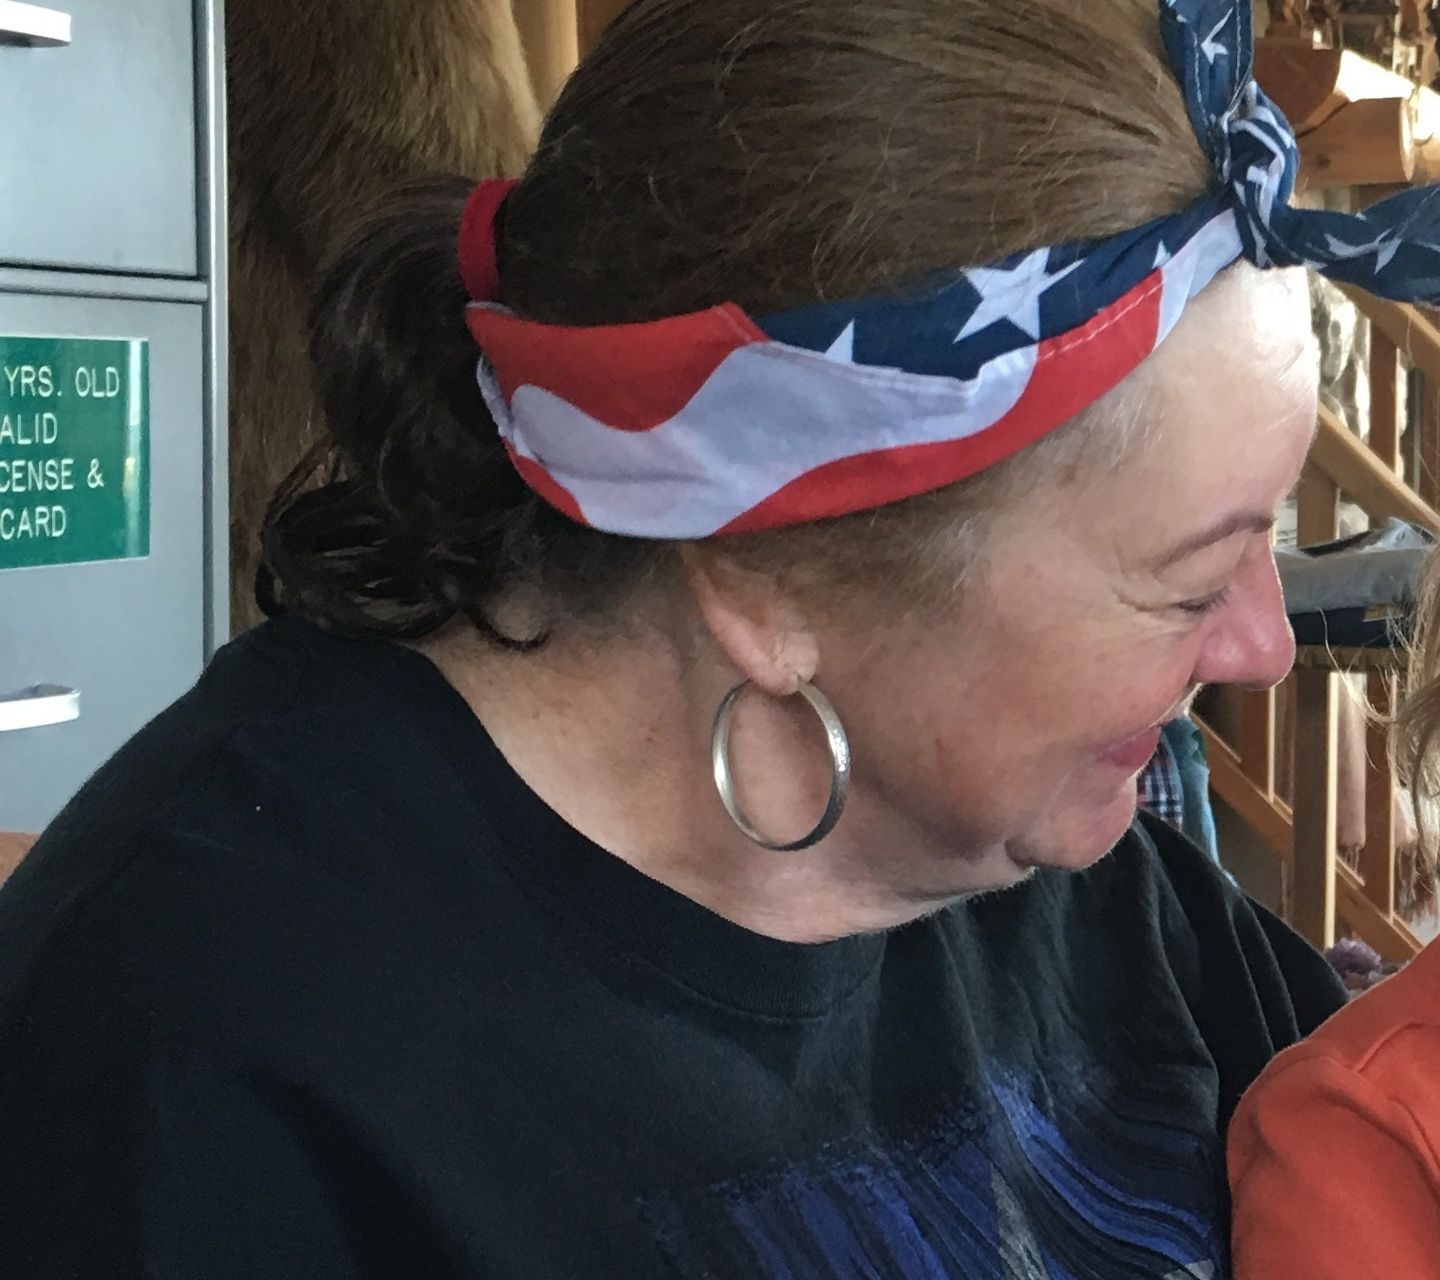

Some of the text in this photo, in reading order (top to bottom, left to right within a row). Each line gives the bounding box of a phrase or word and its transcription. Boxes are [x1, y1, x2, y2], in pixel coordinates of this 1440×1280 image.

[4, 364, 121, 399] YRS. OLD
[86, 457, 105, 489] &
[0, 504, 67, 541] CARD
